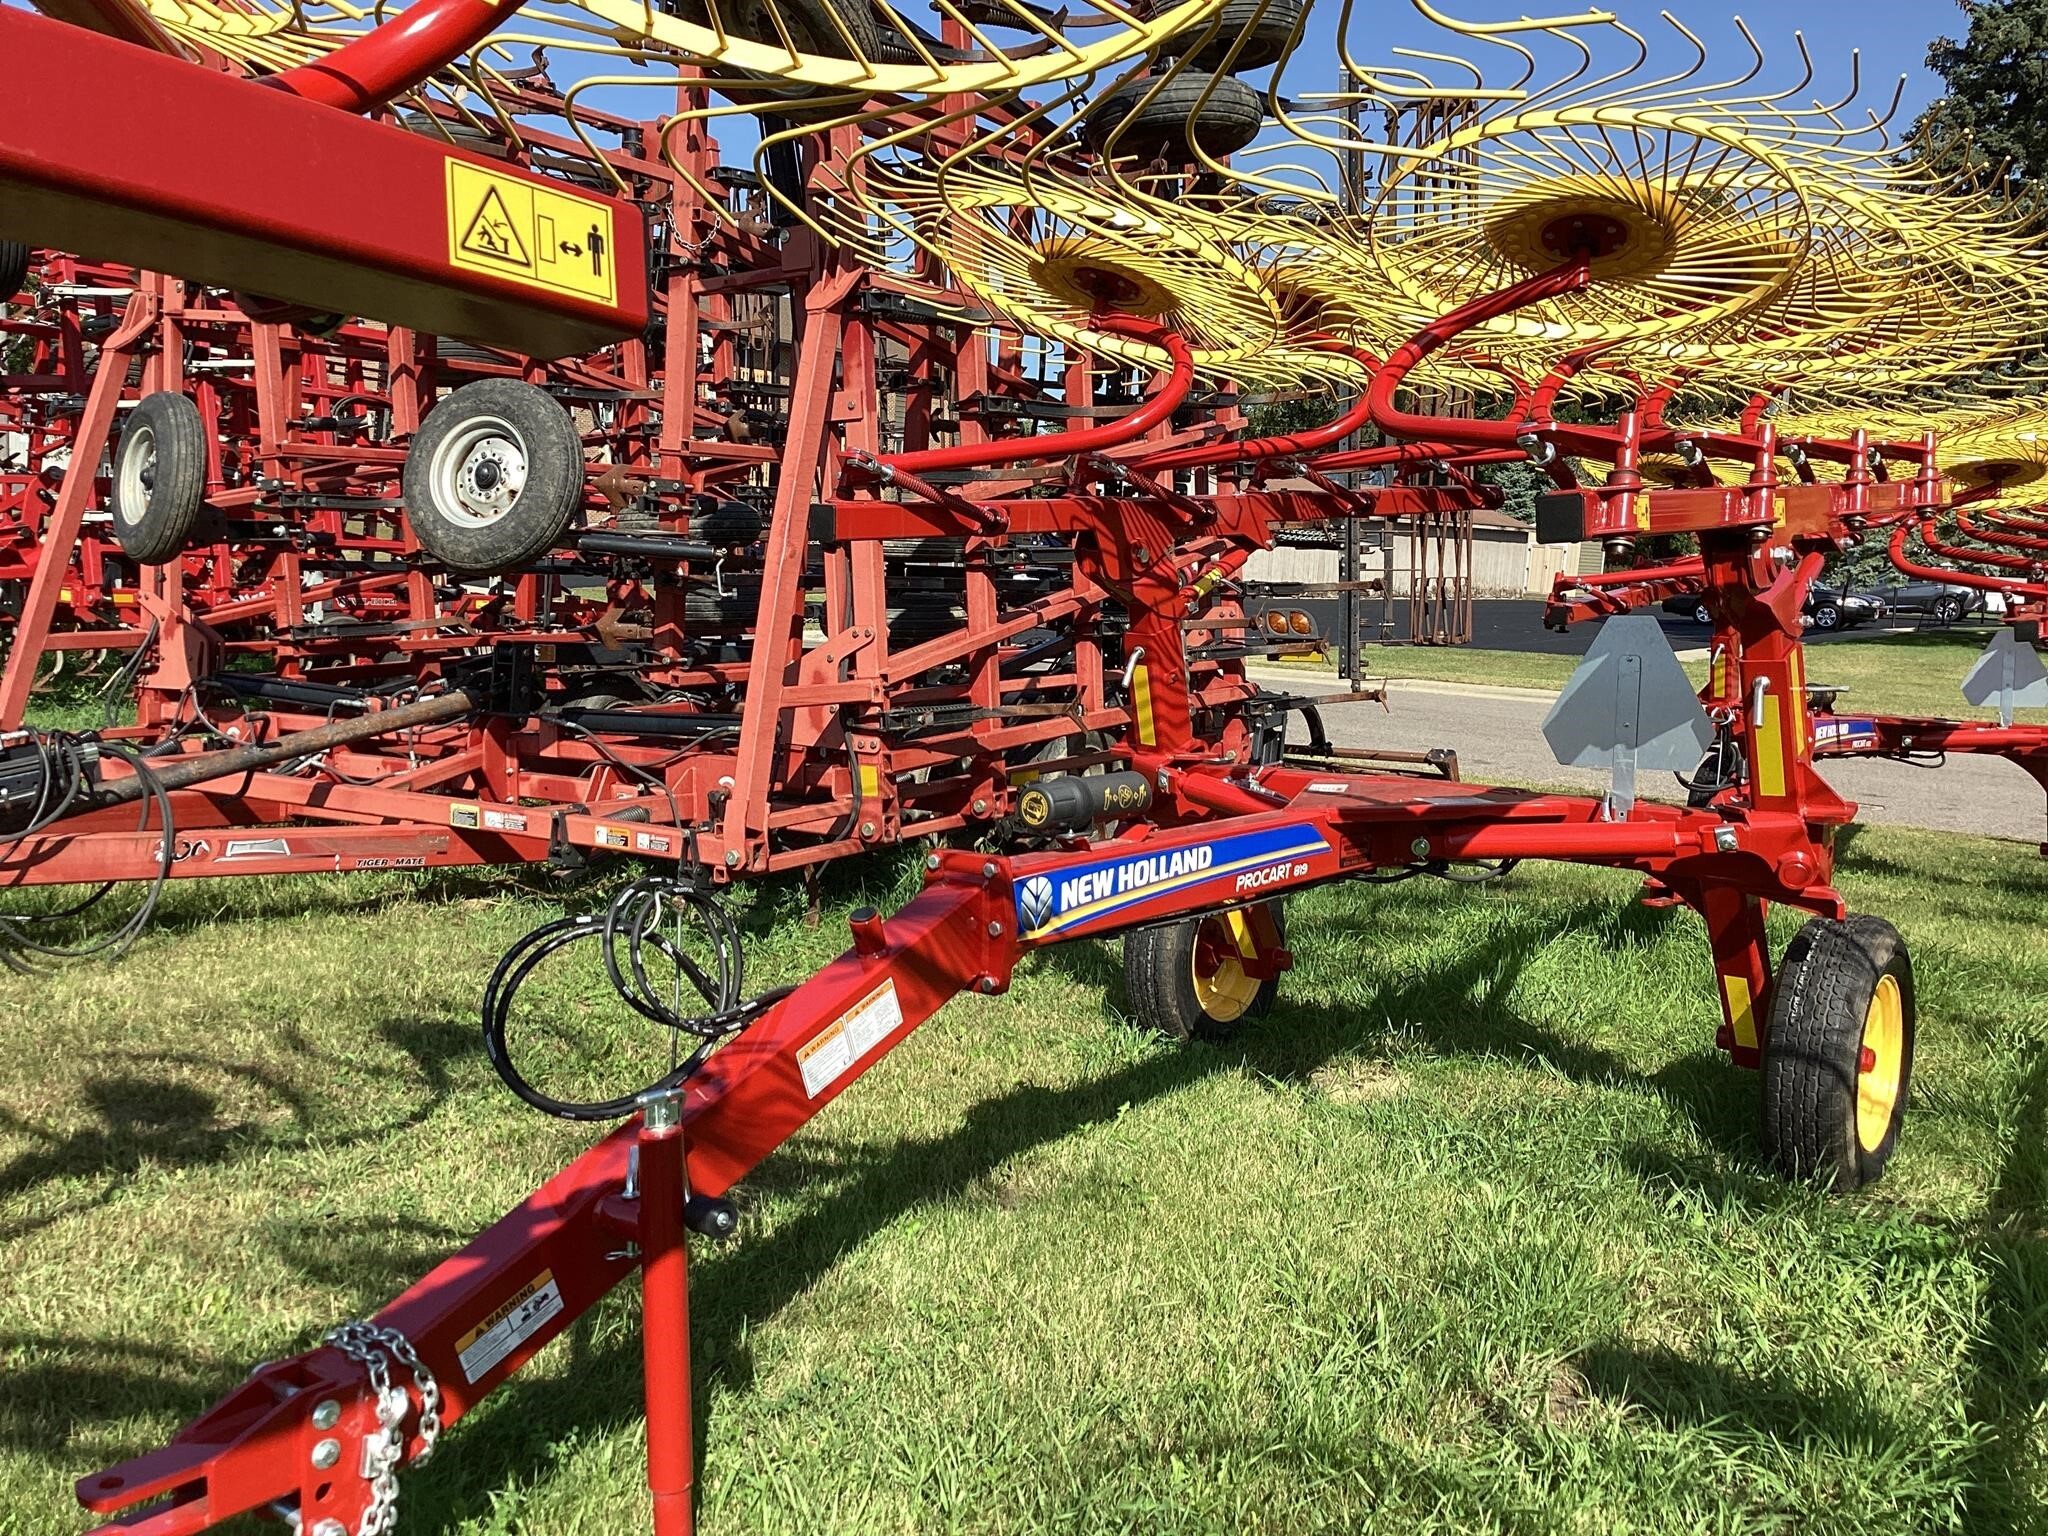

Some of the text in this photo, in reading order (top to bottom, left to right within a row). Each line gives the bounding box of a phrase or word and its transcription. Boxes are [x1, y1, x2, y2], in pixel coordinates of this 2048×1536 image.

[1060, 845, 1212, 911] NEW HOLLAND
[1236, 862, 1309, 893] PROCART 819
[809, 1026, 841, 1053] WARNING
[484, 1284, 536, 1328] WARNING
